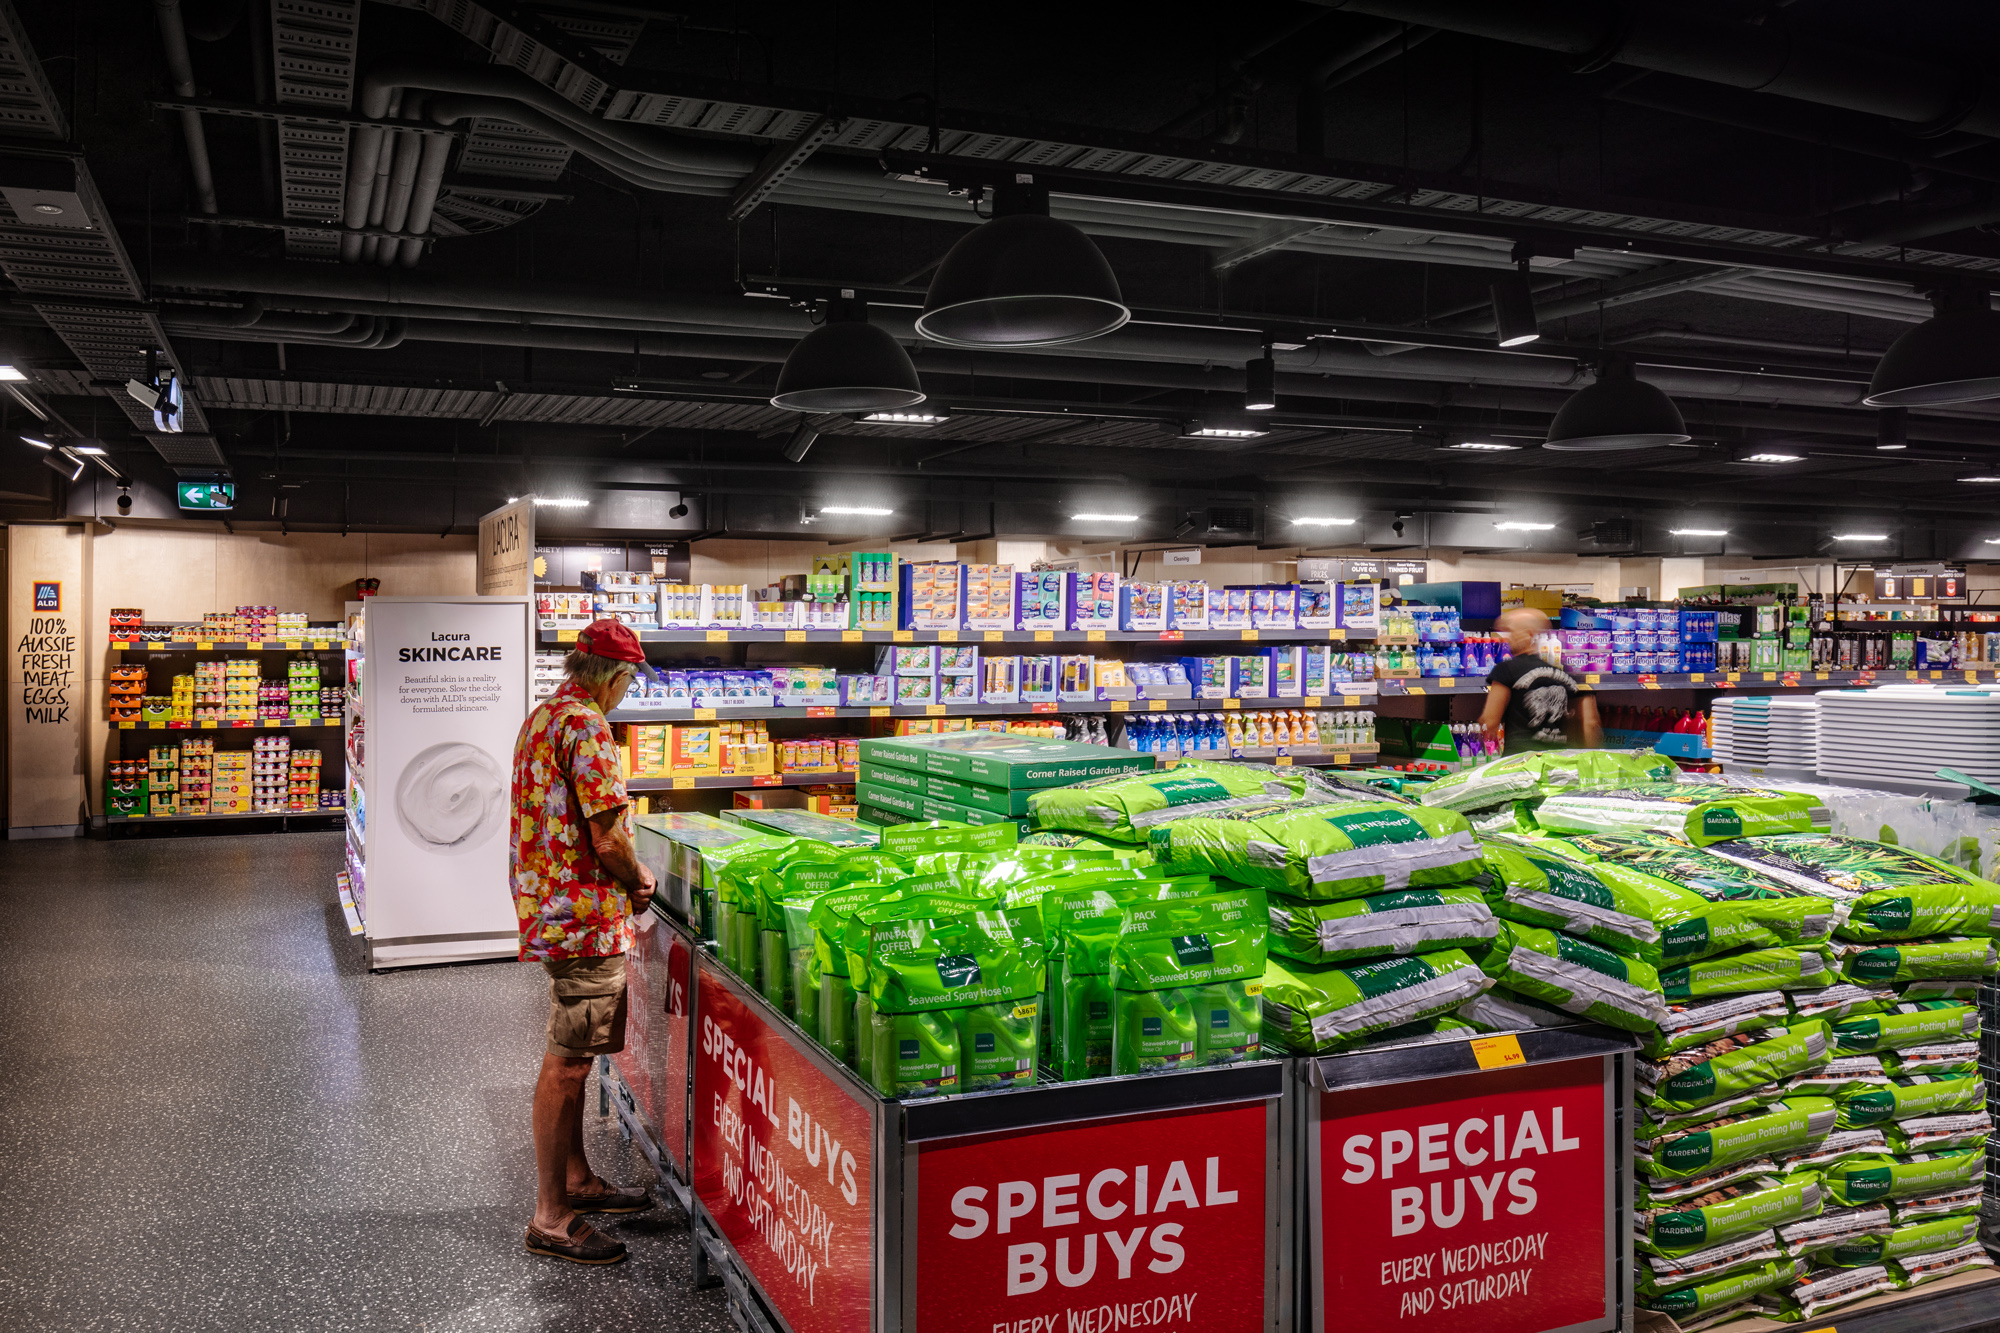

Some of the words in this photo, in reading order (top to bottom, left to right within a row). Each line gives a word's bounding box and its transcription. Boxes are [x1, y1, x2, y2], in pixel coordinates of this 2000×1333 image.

[492, 513, 520, 556] LACURA
[30, 618, 67, 635] 100%
[17, 634, 76, 653] AUSSIE
[431, 632, 470, 642] Lacura
[22, 654, 71, 670] FRESH
[398, 646, 502, 662] SKINCARE
[24, 670, 75, 688] MEAT,
[404, 675, 439, 684] Beautiful
[440, 674, 457, 682] skin
[472, 674, 497, 684] reality
[23, 688, 69, 706] EGGS,
[411, 686, 448, 694] everyone.
[450, 684, 468, 692] Slow
[482, 684, 502, 692] clock
[400, 695, 422, 704] down
[423, 695, 440, 703] with
[441, 694, 467, 702] ALDI's
[468, 694, 500, 703] specially
[26, 706, 69, 724] MILK
[412, 704, 454, 713] formulated
[871, 770, 882, 780] Corner
[884, 772, 896, 781] Raised
[896, 774, 910, 784] Garden
[910, 776, 918, 787] Bed
[1026, 770, 1056, 778] Corner
[1058, 767, 1086, 776] Raised
[1089, 765, 1120, 775] Garden
[1122, 764, 1139, 773] Bed
[868, 790, 879, 801] Corner
[880, 793, 892, 804] Raised
[892, 796, 906, 807] Garden
[906, 800, 914, 810] Bed
[908, 836, 926, 844] PACK
[987, 830, 1004, 838] PACK
[978, 838, 996, 847] OFFER
[796, 872, 819, 880] TWIN
[820, 872, 840, 880] PACK
[911, 882, 932, 892] TWIN
[934, 880, 956, 890] PACK
[826, 896, 848, 904] TWIN
[848, 894, 870, 902] PACK
[930, 900, 954, 908] TWIN
[1064, 900, 1085, 910] TWIN
[1086, 899, 1108, 908] PACK
[1212, 902, 1231, 912] TWIN
[1232, 898, 1248, 909] PACK
[832, 904, 858, 912] OFFER
[1074, 910, 1101, 920] OFFER
[1134, 910, 1156, 920] PACK
[1222, 911, 1242, 921] OFFER
[880, 941, 911, 952] OFFER
[1667, 932, 1706, 945] GARDENLINE
[1858, 960, 1898, 968] GARDENLINE
[1906, 954, 1941, 964] Premium
[1942, 950, 1970, 961] Potting
[1972, 949, 1984, 959] Mix
[1149, 971, 1188, 984] Seaweed
[1190, 969, 1212, 981] Spray
[1214, 966, 1232, 976] Hose
[1233, 964, 1244, 974] On
[1696, 966, 1738, 981] Premium
[1742, 962, 1776, 975] Potting
[1778, 959, 1796, 970] Mix
[908, 992, 951, 1006] Seaweed
[954, 990, 978, 1002] Spray
[981, 988, 1002, 997] Hose
[1002, 986, 1012, 994] On
[1886, 1022, 1918, 1036] Premium
[1920, 1020, 1946, 1032] Potting
[1948, 1018, 1960, 1028] Mix
[1718, 1059, 1756, 1078] Premium
[1756, 1050, 1787, 1066] Potting
[1789, 1043, 1804, 1056] Mix
[1671, 1076, 1714, 1088] GARDENLINE
[702, 1014, 780, 1129] SPECIAL
[788, 1096, 858, 1206] BUYS
[1718, 1132, 1756, 1148] Premium
[1758, 1124, 1788, 1139] Potting
[1790, 1120, 1804, 1131] Mix
[1342, 1106, 1580, 1184] SPECIAL
[1667, 1145, 1710, 1157] GARDENLINE
[714, 1091, 746, 1159] EVERY
[748, 1125, 834, 1268] WEDNESDAY
[949, 1156, 1238, 1240] SPECIAL
[1391, 1168, 1538, 1238] BUYS
[1712, 1209, 1750, 1228] Premium
[1752, 1200, 1782, 1216] Potting
[1784, 1194, 1798, 1205] Mix
[722, 1152, 746, 1206] AND
[746, 1180, 818, 1306] SATURDAY
[1659, 1223, 1704, 1235] GARDENLINE
[1888, 1240, 1920, 1250] Premium
[1922, 1234, 1946, 1246] Potting
[1948, 1231, 1960, 1240] Mix
[1006, 1222, 1186, 1296] BUYS
[1381, 1252, 1436, 1286] EVERY
[1441, 1232, 1548, 1276] WEDNESDAY
[1704, 1284, 1741, 1303] Premium
[1743, 1274, 1774, 1289] Potting
[1775, 1266, 1792, 1280] Mix
[1400, 1286, 1434, 1319] AND
[1439, 1268, 1532, 1310] SATURDAY
[1066, 1292, 1198, 1333] WEDNESDAY
[1652, 1301, 1697, 1311] GARDENLINE
